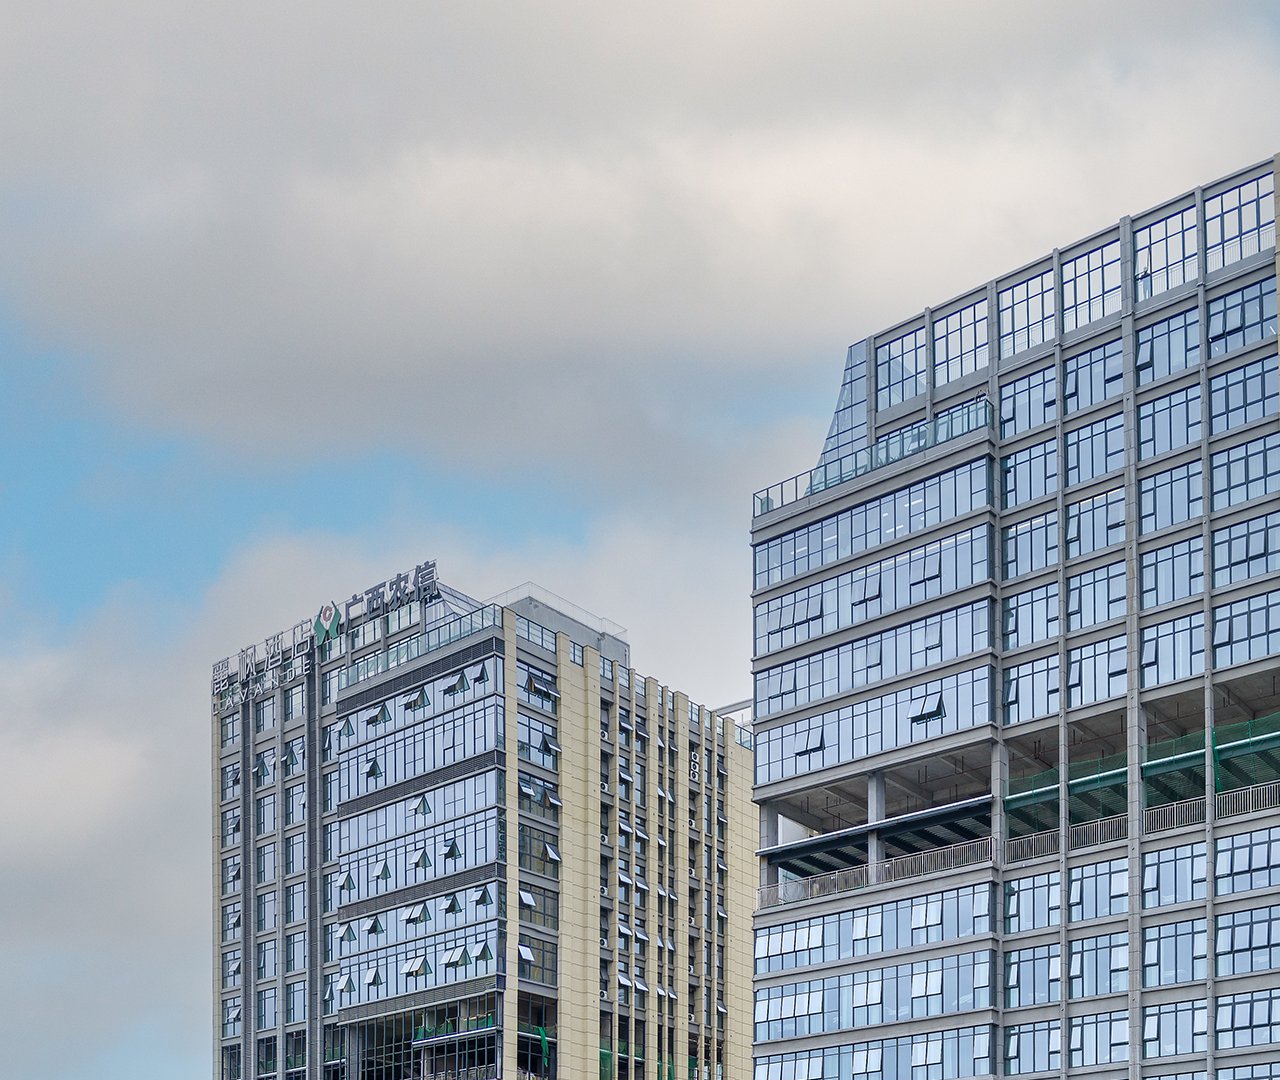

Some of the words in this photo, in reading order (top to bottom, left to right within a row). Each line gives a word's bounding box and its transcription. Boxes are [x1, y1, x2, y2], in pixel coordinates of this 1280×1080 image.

[345, 561, 439, 633] 广西农信
[213, 656, 311, 716] LAVANDE
